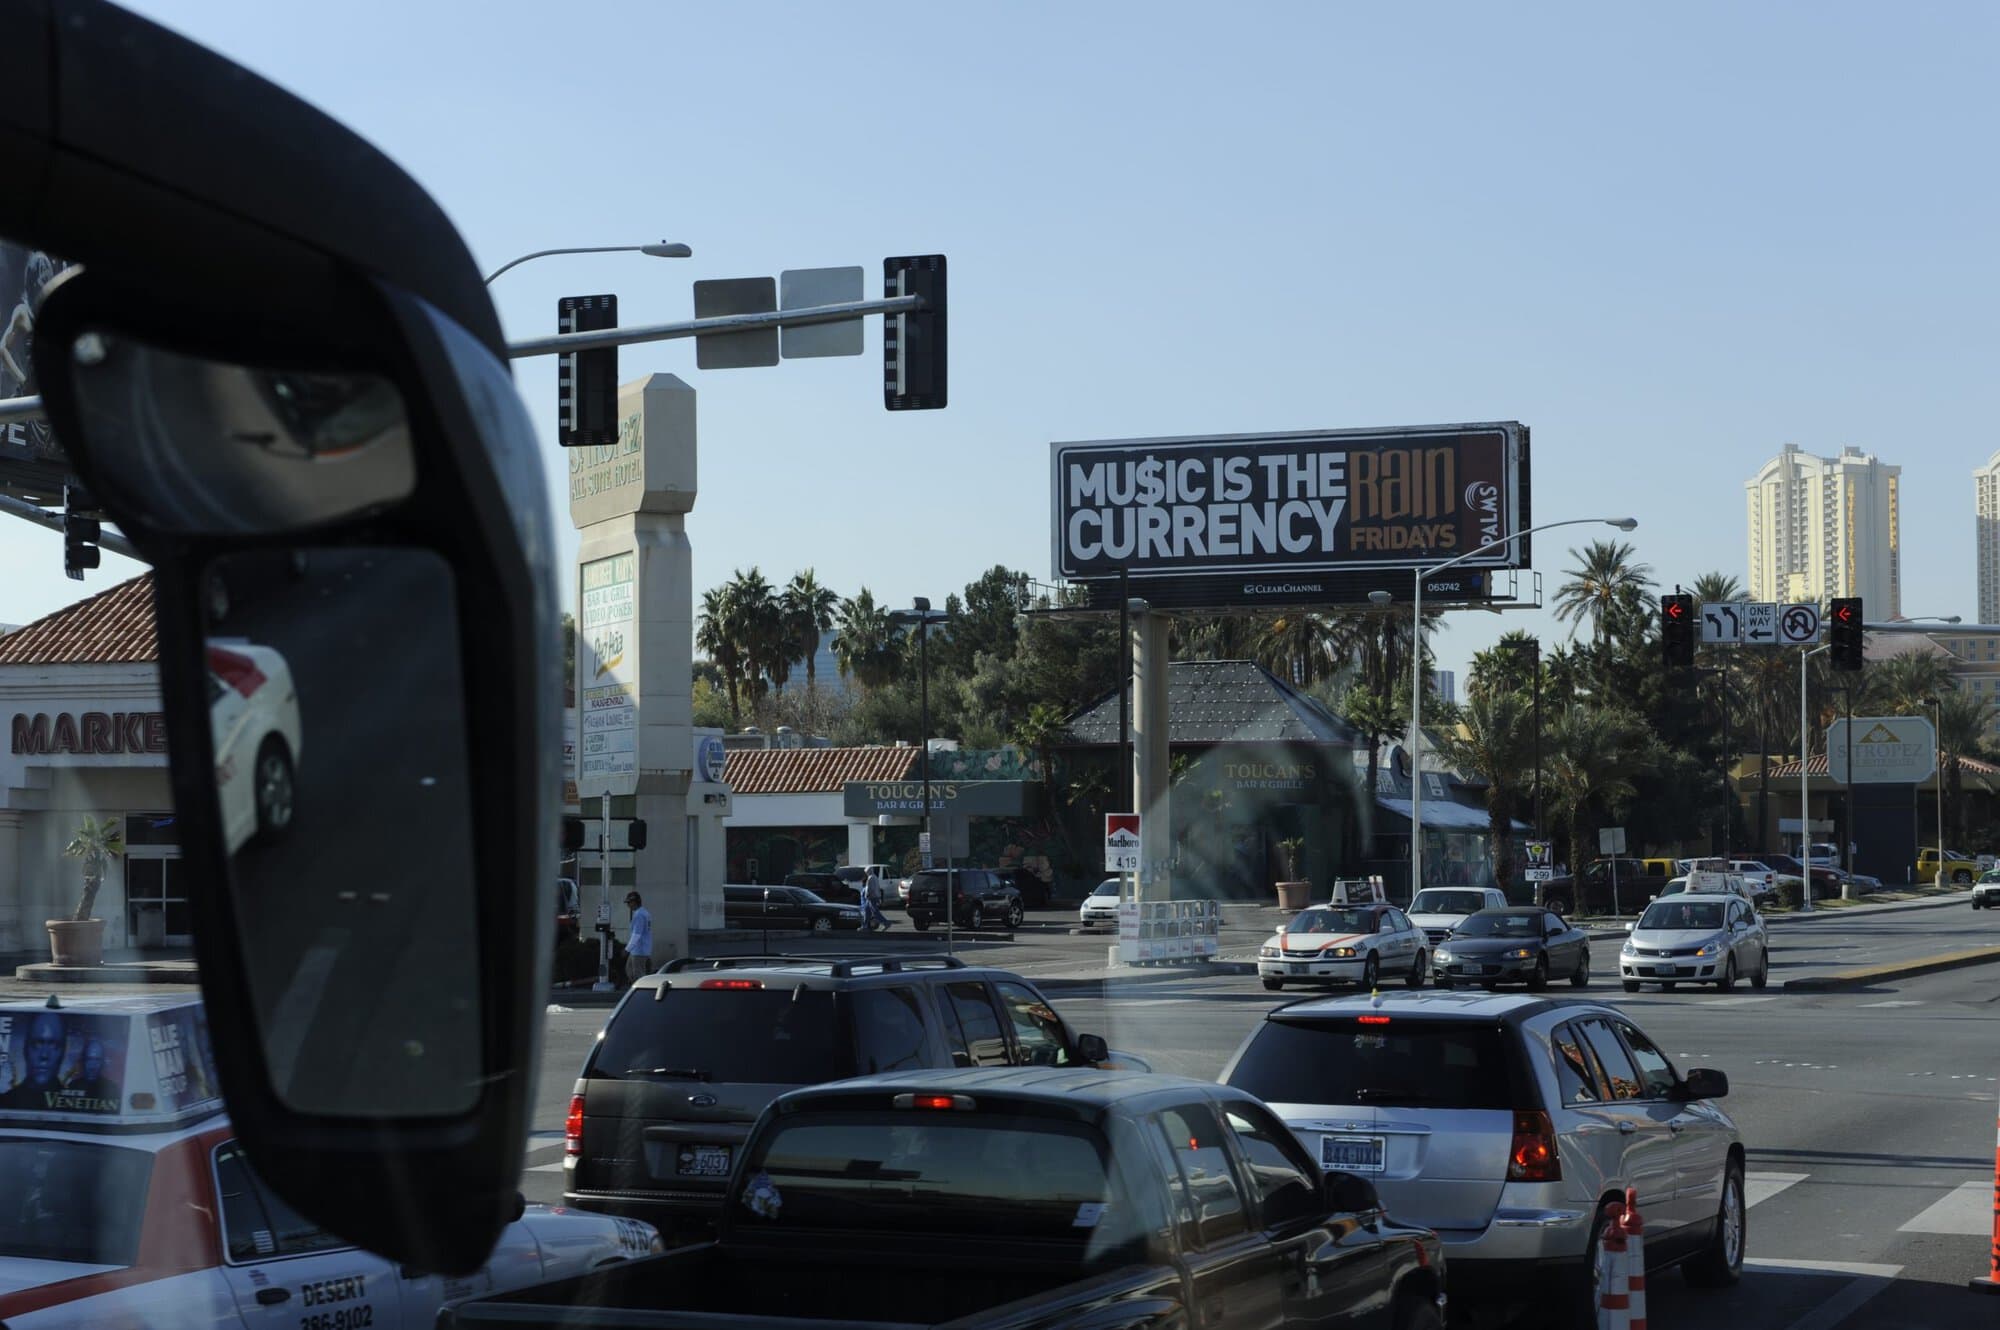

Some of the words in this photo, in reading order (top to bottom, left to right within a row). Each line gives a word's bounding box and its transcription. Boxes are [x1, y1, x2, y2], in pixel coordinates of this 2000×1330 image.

[615, 458, 641, 488] HOTEL
[1213, 456, 1252, 502] IS
[1258, 452, 1347, 500] THE
[1479, 485, 1498, 547] PALMS
[1069, 499, 1346, 560] CURRENCY
[1351, 524, 1456, 550] FRIDAYS
[1427, 583, 1460, 592] 063742
[1749, 606, 1770, 616] ONE
[1749, 617, 1770, 627] WAY
[12, 712, 168, 754] MARKE
[1224, 763, 1317, 779] TOUCAN'S
[866, 784, 958, 799] TOUCAN'S
[1236, 781, 1256, 789] BAR
[877, 801, 897, 809] BAR
[909, 801, 946, 809] GRLE
[1107, 834, 1139, 848] Marlboro
[151, 1022, 180, 1051] BLUE
[155, 1048, 186, 1079] MAN
[44, 1091, 120, 1112] VENETIAN
[302, 1275, 365, 1307] DESERT
